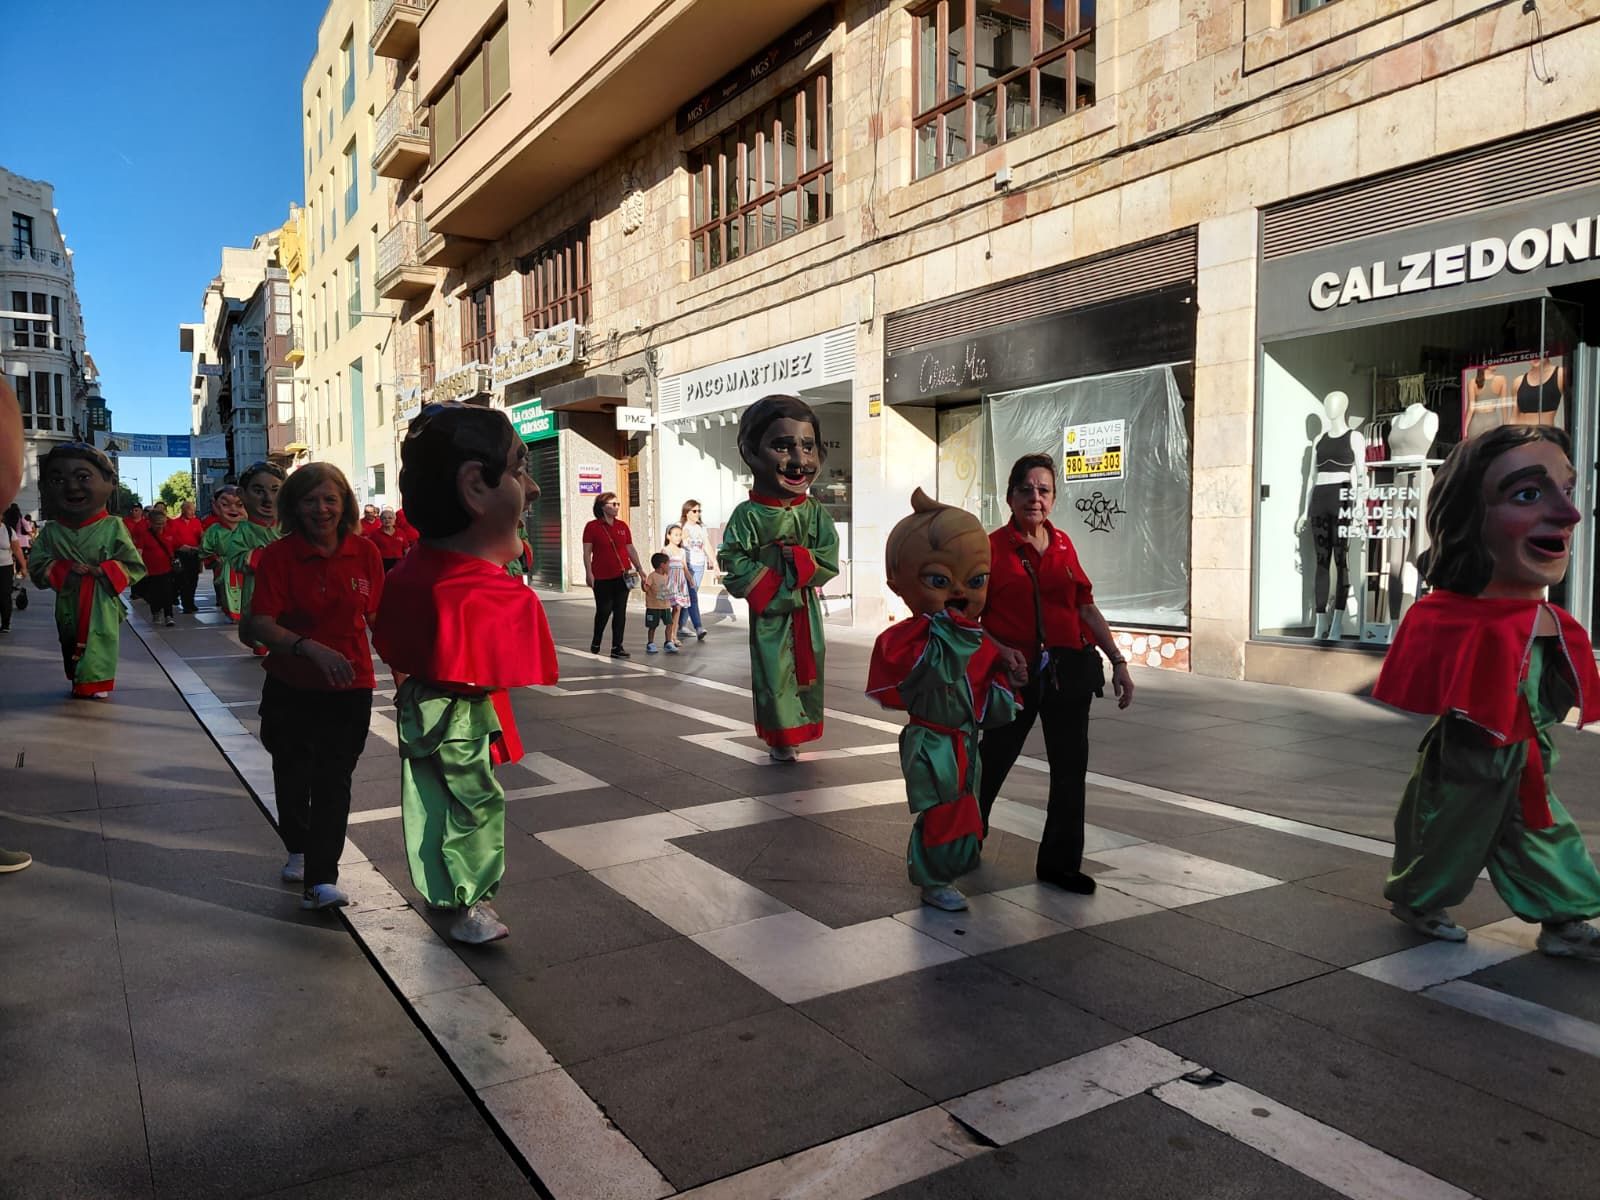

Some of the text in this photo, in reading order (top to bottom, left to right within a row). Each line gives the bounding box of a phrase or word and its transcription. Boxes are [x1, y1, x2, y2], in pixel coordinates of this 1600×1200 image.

[1310, 214, 1600, 309] CALZEDON
[1482, 355, 1518, 366] COMPACT
[625, 414, 646, 424] PMZ
[1080, 423, 1121, 436] SUAVIS
[1080, 435, 1120, 448] DOMUS
[1066, 458, 1082, 473] 980
[1103, 453, 1120, 470] 303
[1338, 506, 1418, 519] MOLDEAN
[1338, 525, 1409, 538] REALZAN
